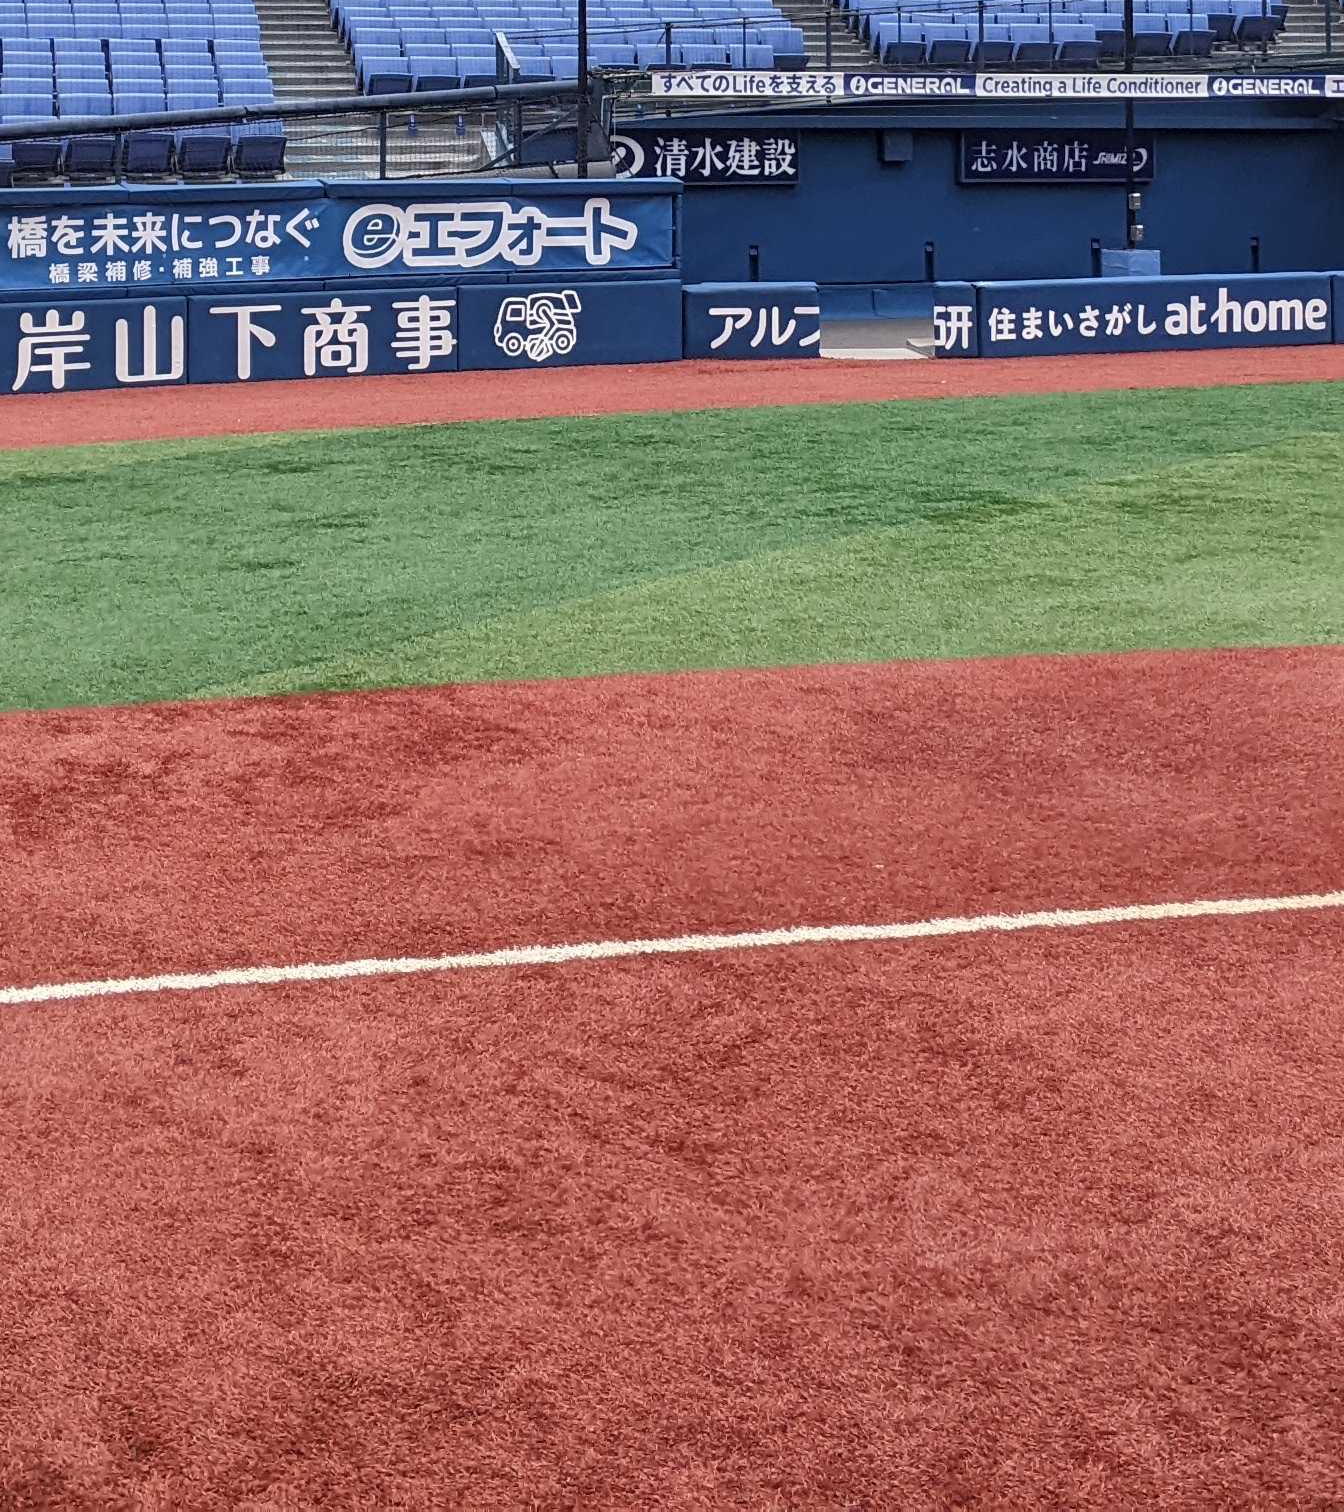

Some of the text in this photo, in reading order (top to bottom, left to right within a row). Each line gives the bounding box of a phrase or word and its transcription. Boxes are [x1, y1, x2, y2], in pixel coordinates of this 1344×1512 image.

[660, 74, 837, 95] すべてのLifeを支える
[868, 77, 971, 95] GENERAL
[982, 76, 1201, 97] Creating a Life Conditioner
[1228, 78, 1320, 95] GENERAL
[653, 136, 798, 178] 清水建設
[971, 140, 1089, 173] 志水商店
[6, 207, 320, 261] 橋を未来につなぐ
[48, 255, 272, 285] 橋梁補修・補強工事
[989, 302, 1157, 342] 住まいさがし
